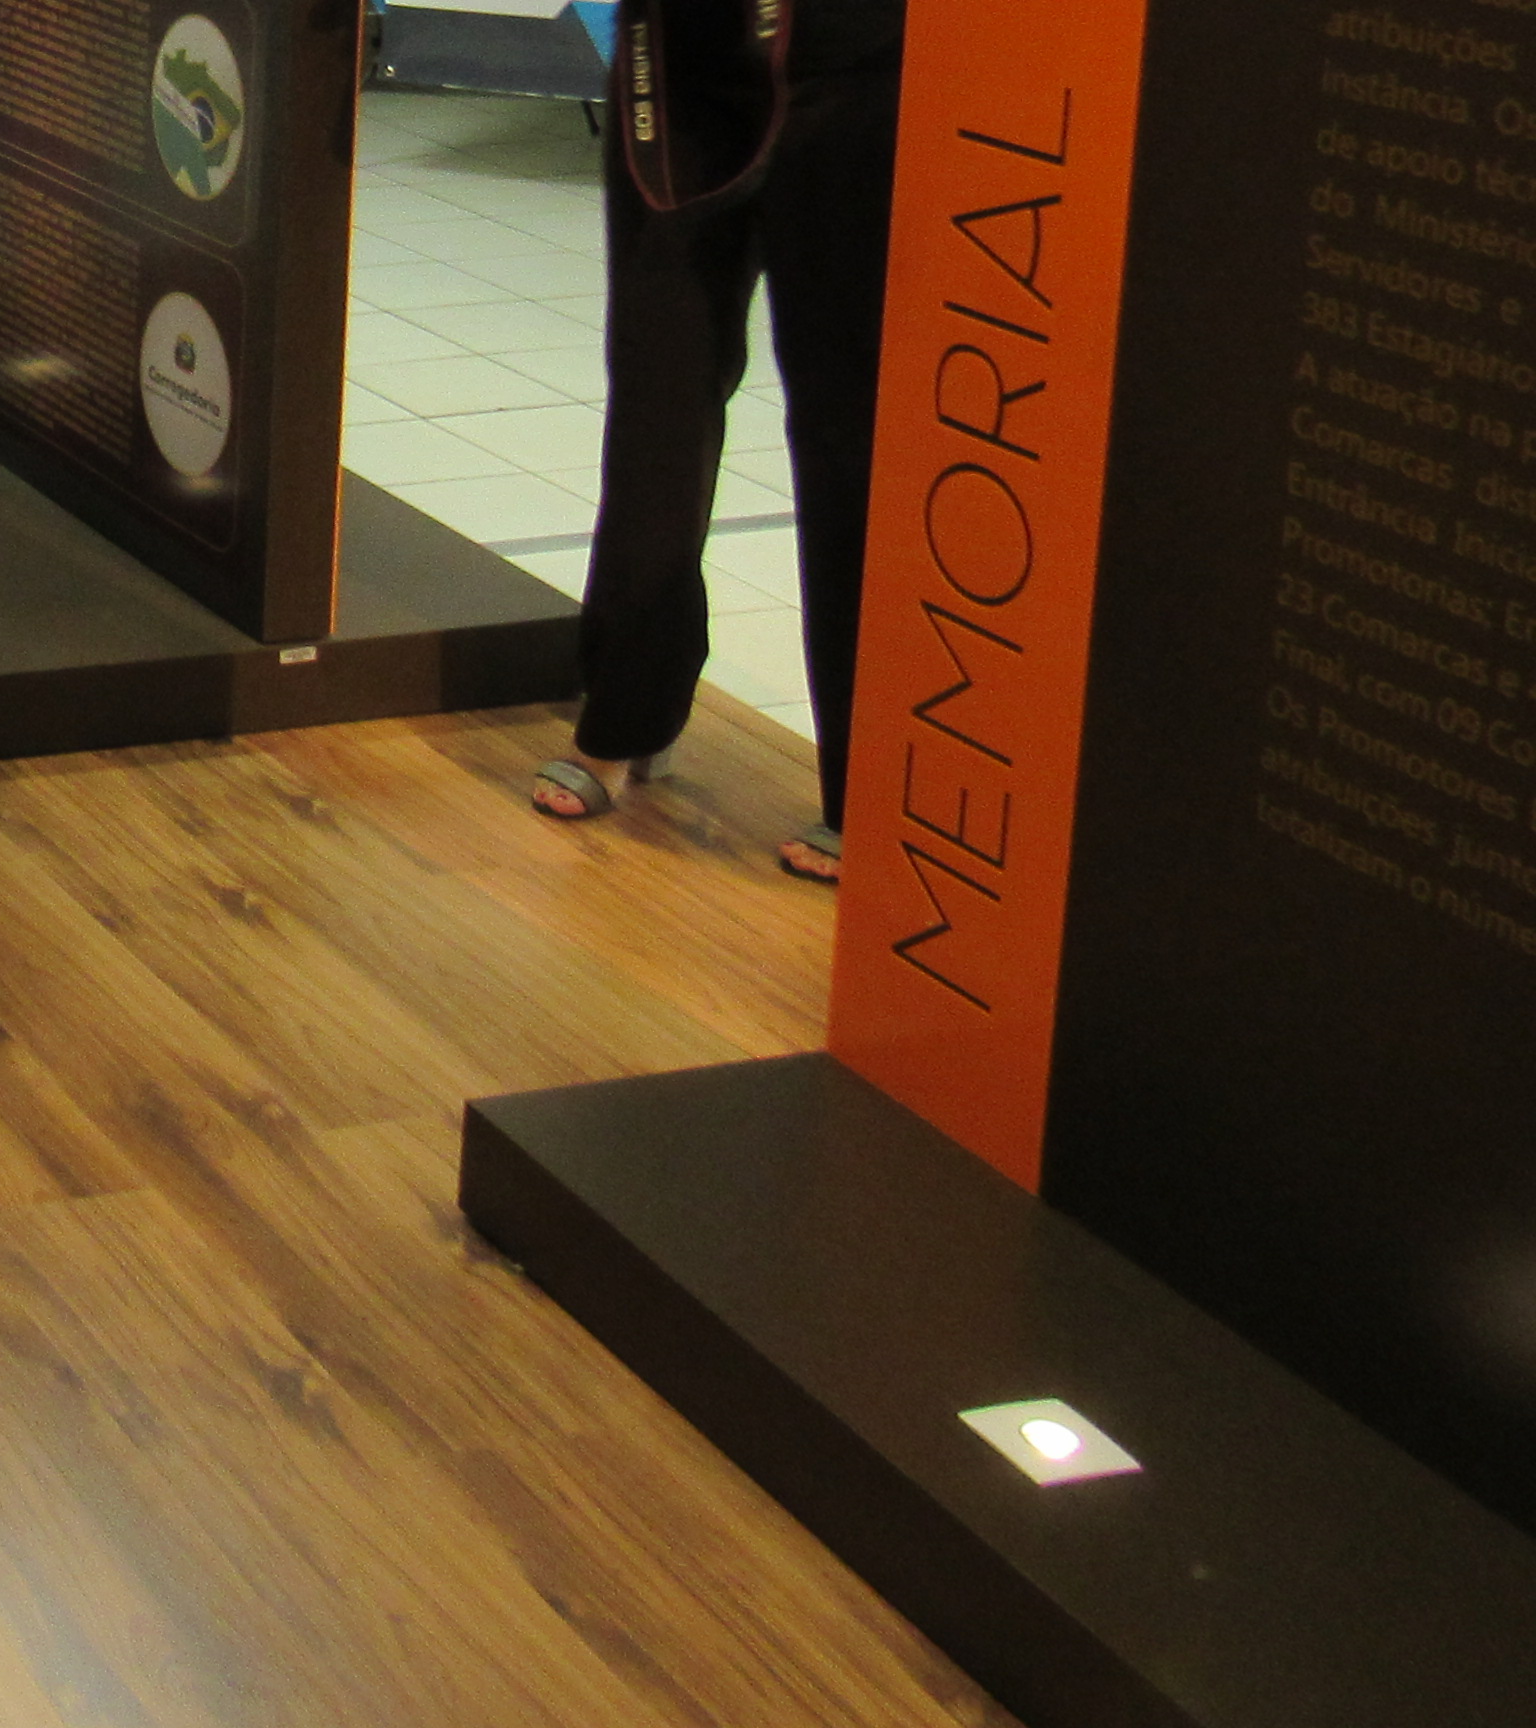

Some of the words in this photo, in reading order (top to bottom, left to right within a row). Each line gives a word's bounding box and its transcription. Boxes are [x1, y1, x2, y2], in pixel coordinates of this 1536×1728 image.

[1324, 5, 1518, 71] atribuições
[634, 99, 655, 142] EOS
[1315, 118, 1358, 162] de
[1366, 139, 1465, 186] apoio
[1475, 156, 1536, 203] téc
[1309, 178, 1356, 219] do
[1301, 289, 1358, 340] 383
[1304, 233, 1483, 315] Servidores
[1499, 297, 1523, 326] e
[1293, 350, 1319, 387] A
[1328, 366, 1459, 430] atuação
[1468, 414, 1513, 448] na
[1290, 404, 1454, 491] Comarcas
[1287, 460, 1438, 545] Entrância
[891, 87, 1072, 1013] MEMORIAL
[1277, 572, 1314, 615] 23
[1322, 593, 1488, 685] Comarcas
[1496, 669, 1520, 699] e
[1357, 673, 1430, 722] com
[1437, 696, 1481, 744] 09
[1259, 745, 1437, 847] atribuições
[1266, 685, 1308, 729] Os
[1318, 705, 1518, 820] Promotores
[1256, 793, 1402, 890] totalizam
[1409, 875, 1430, 903] o
